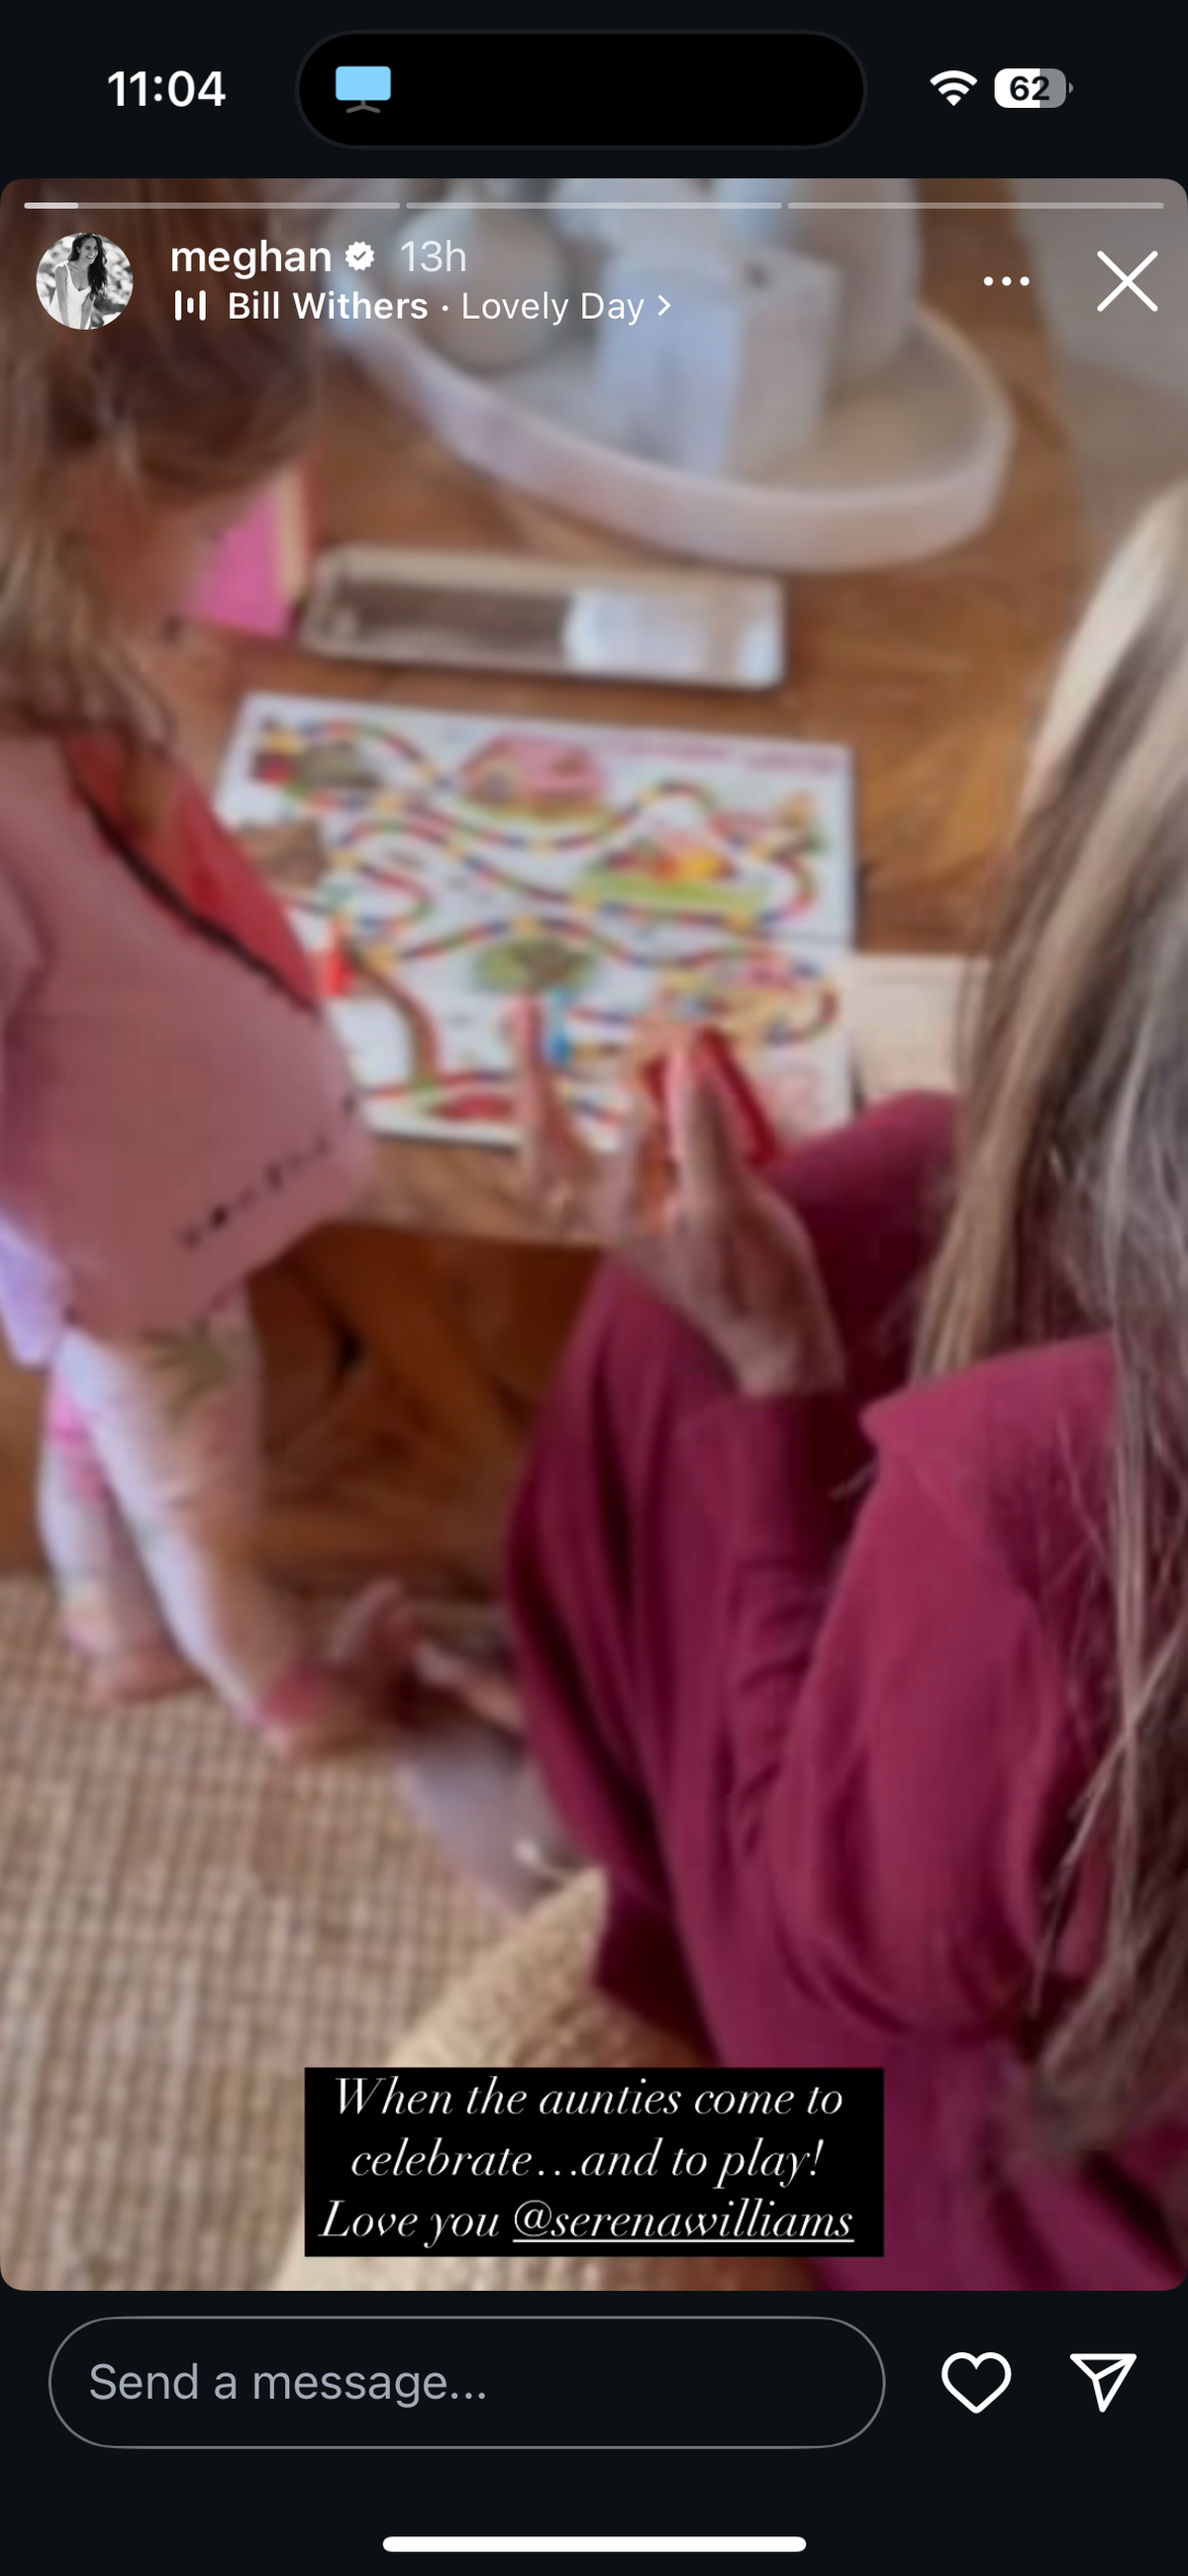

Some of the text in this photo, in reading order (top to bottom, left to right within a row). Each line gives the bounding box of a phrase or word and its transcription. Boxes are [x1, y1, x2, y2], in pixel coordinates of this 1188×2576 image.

[107, 69, 227, 108] 11:04
[1009, 74, 1051, 101] 62
[89, 2362, 198, 2401] Send
[213, 2372, 238, 2401] a
